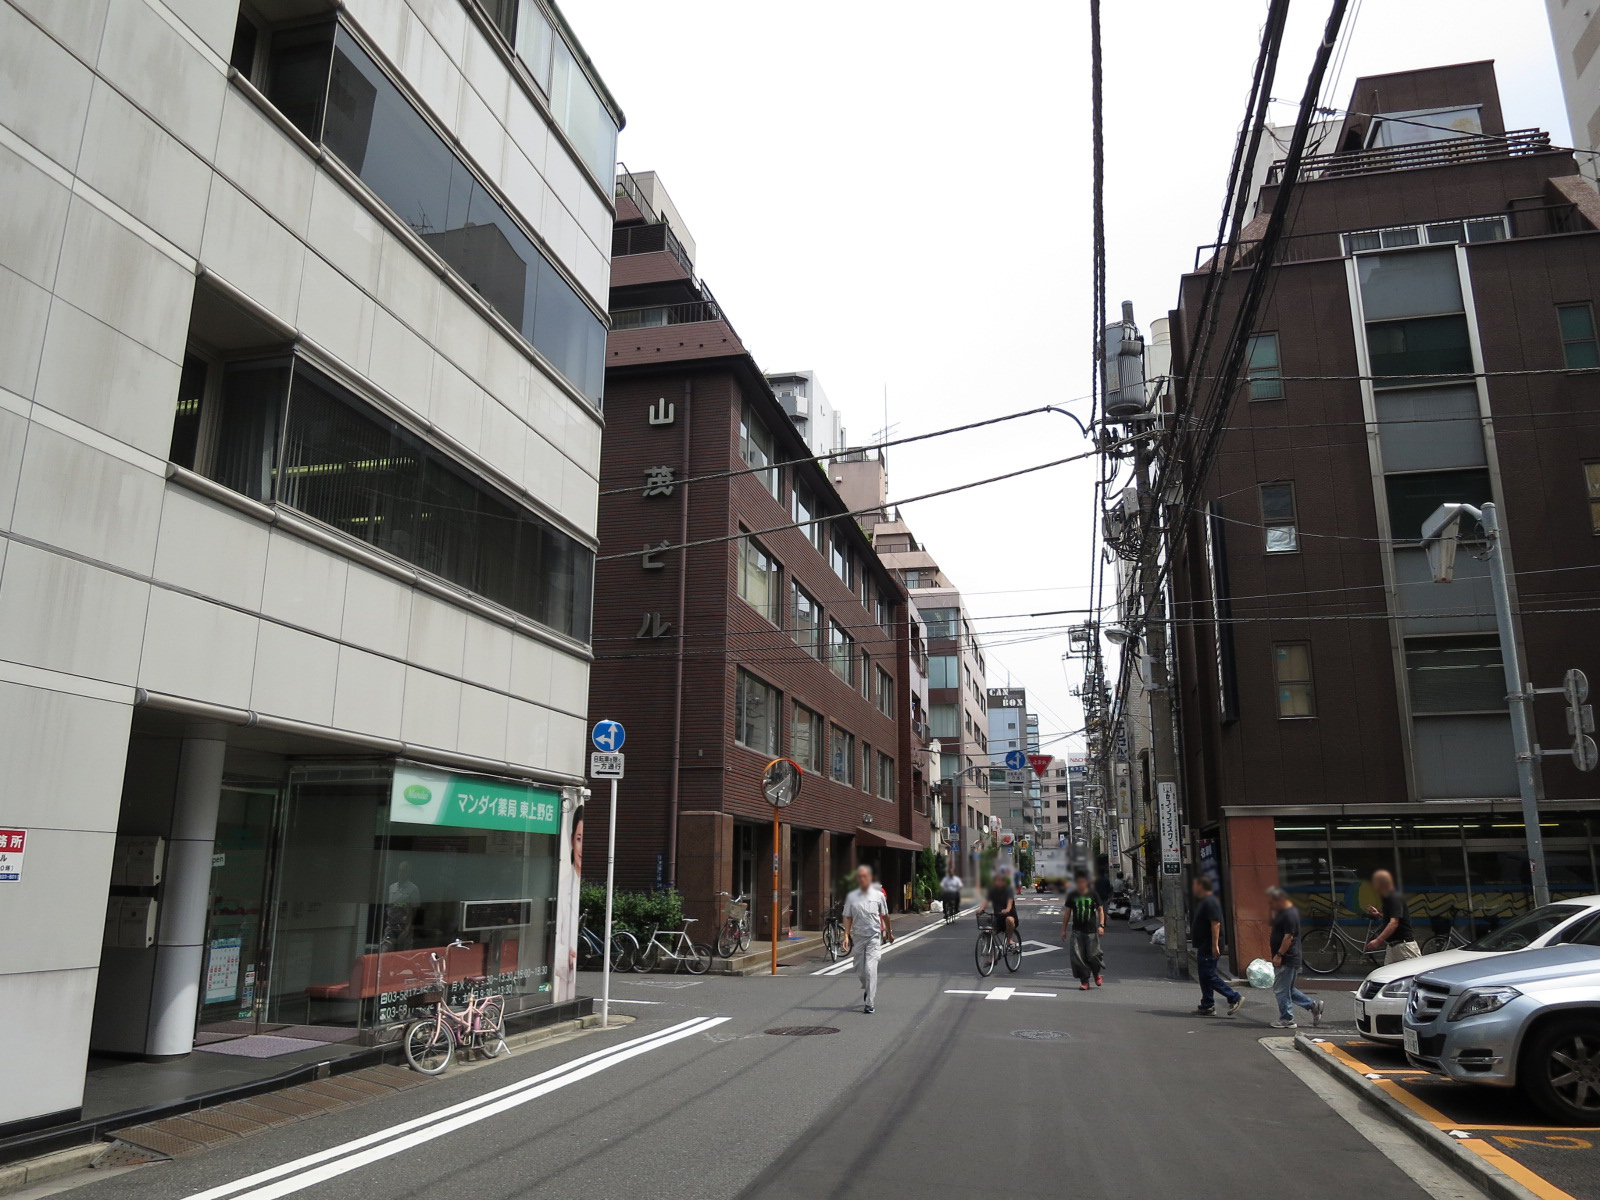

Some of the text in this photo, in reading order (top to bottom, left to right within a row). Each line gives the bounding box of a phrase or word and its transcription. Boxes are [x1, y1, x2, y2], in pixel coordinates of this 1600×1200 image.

[636, 398, 675, 638] 山茂ビル
[989, 688, 1009, 697] CAN
[1002, 698, 1024, 707] BOX
[457, 793, 554, 822] マンダイ薬局 東上野店
[211, 856, 224, 866] pen
